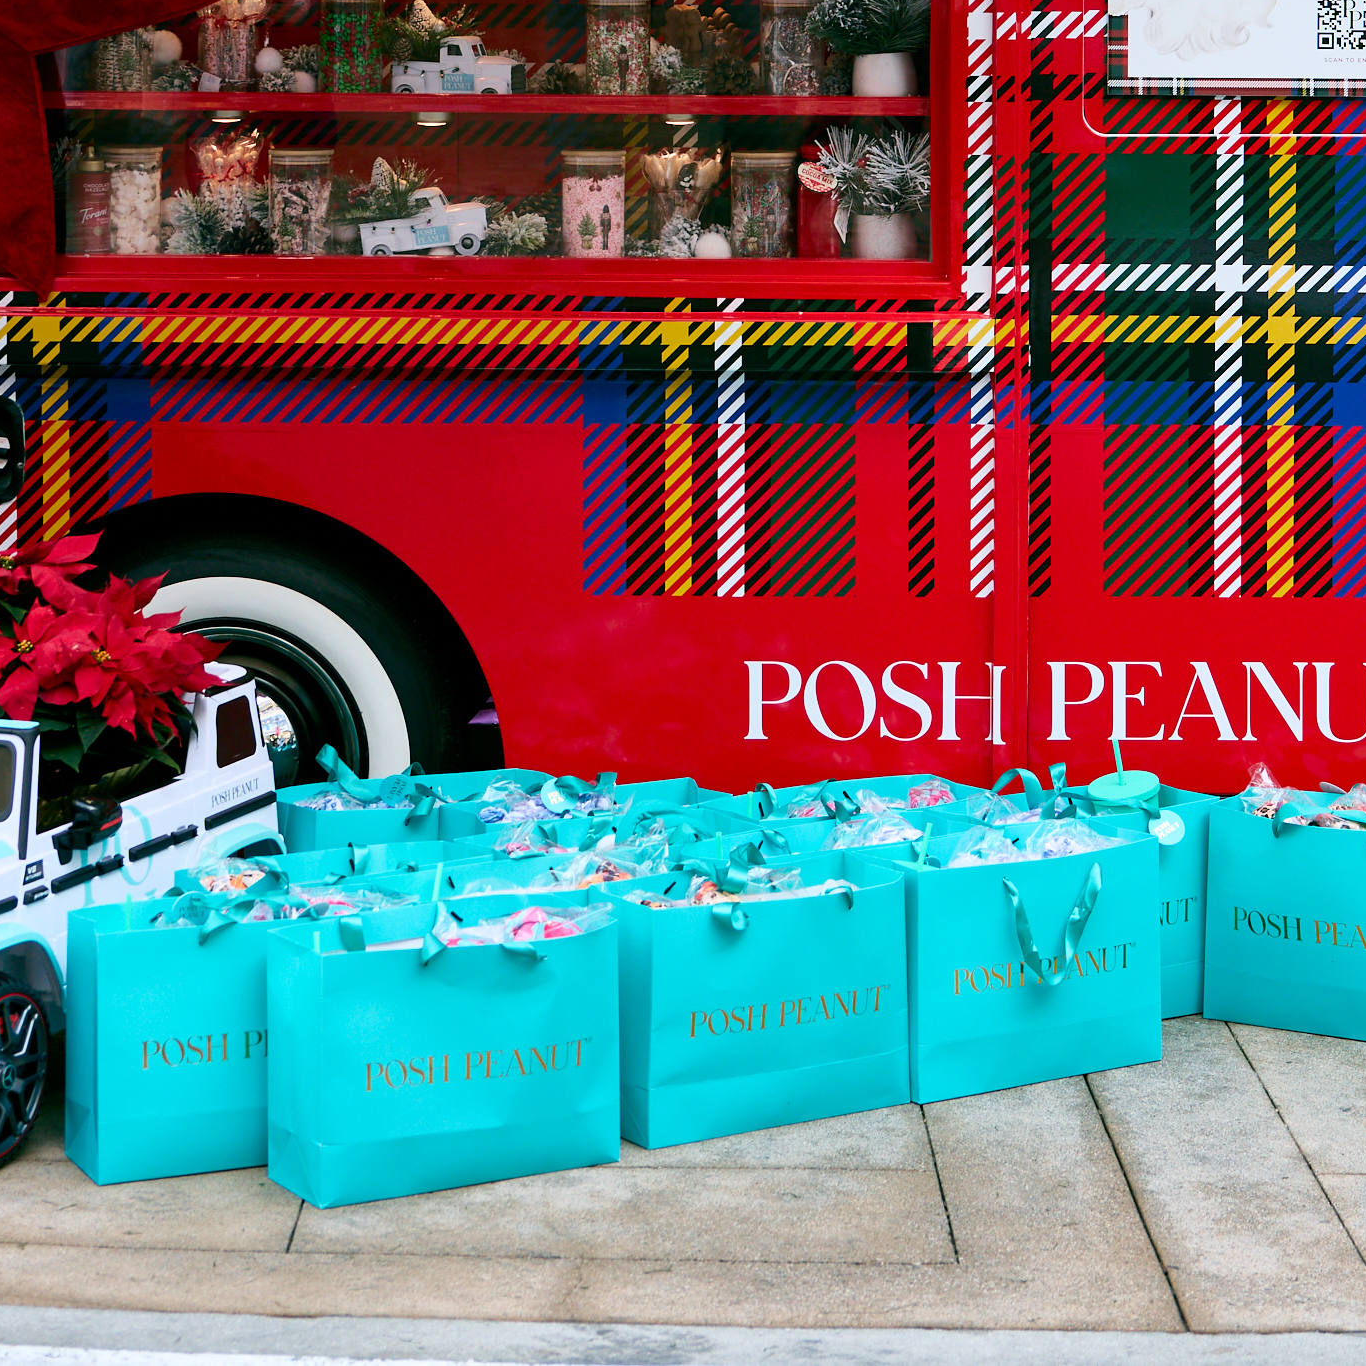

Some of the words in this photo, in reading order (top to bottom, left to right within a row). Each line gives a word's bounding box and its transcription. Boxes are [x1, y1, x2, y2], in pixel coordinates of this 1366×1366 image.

[80, 205, 108, 224] Torani
[743, 660, 1007, 746] POSH
[211, 788, 231, 808] POSH
[232, 777, 260, 800] PEANUT
[1233, 904, 1303, 942] POSH
[953, 960, 1025, 996] POSH
[689, 1003, 768, 1039] POSH
[778, 985, 887, 1029] PEANUT
[142, 1032, 229, 1071] POSH
[365, 1053, 450, 1093] POSH
[464, 1037, 589, 1082] PEANUT
